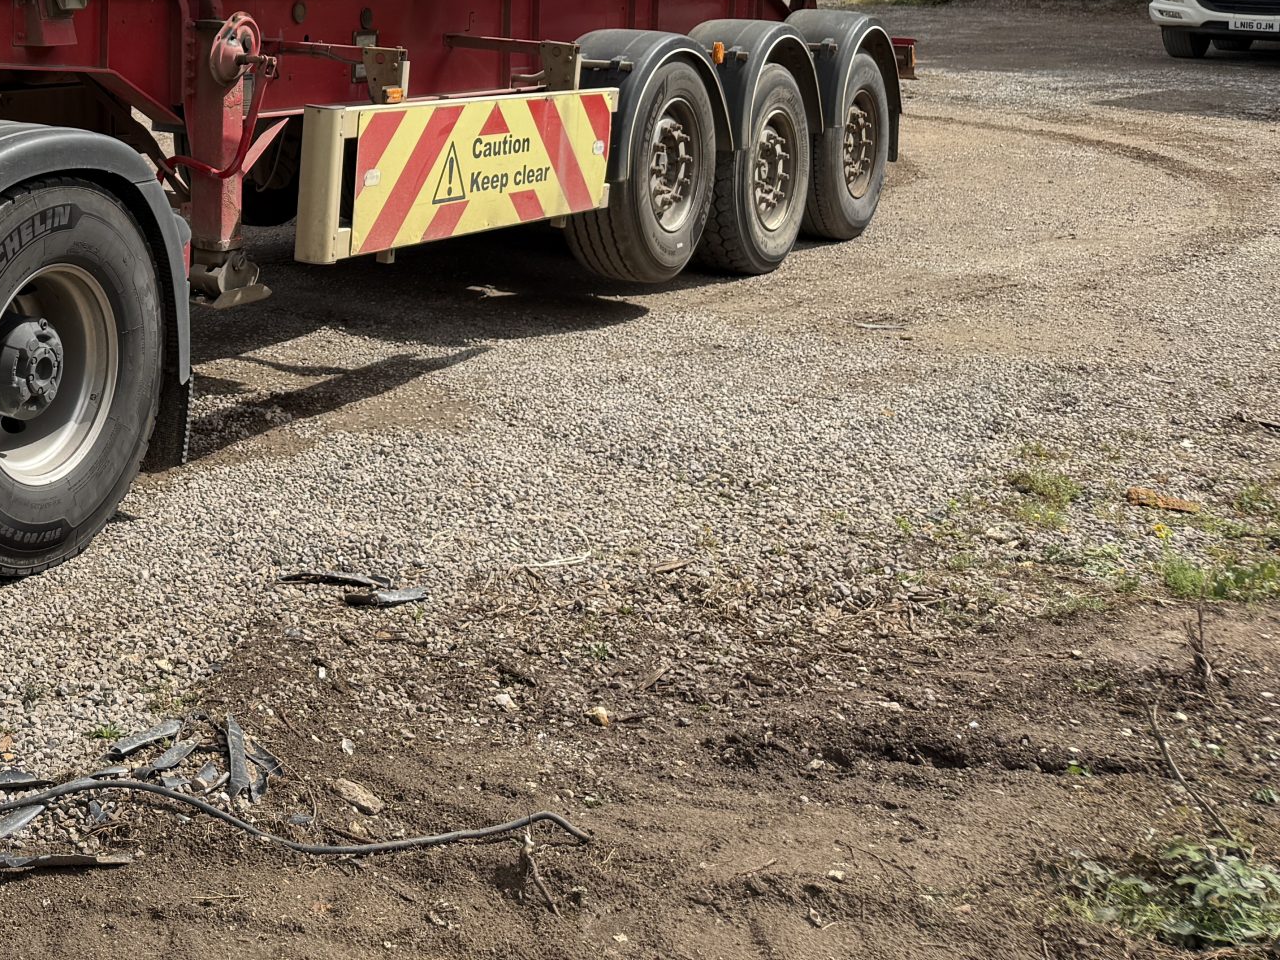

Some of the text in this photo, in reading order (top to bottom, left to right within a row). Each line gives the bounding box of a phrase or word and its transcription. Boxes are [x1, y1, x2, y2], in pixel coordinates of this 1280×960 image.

[1234, 20, 1254, 29] LN16
[472, 133, 531, 159] Caution
[469, 164, 551, 194] Keep clear
